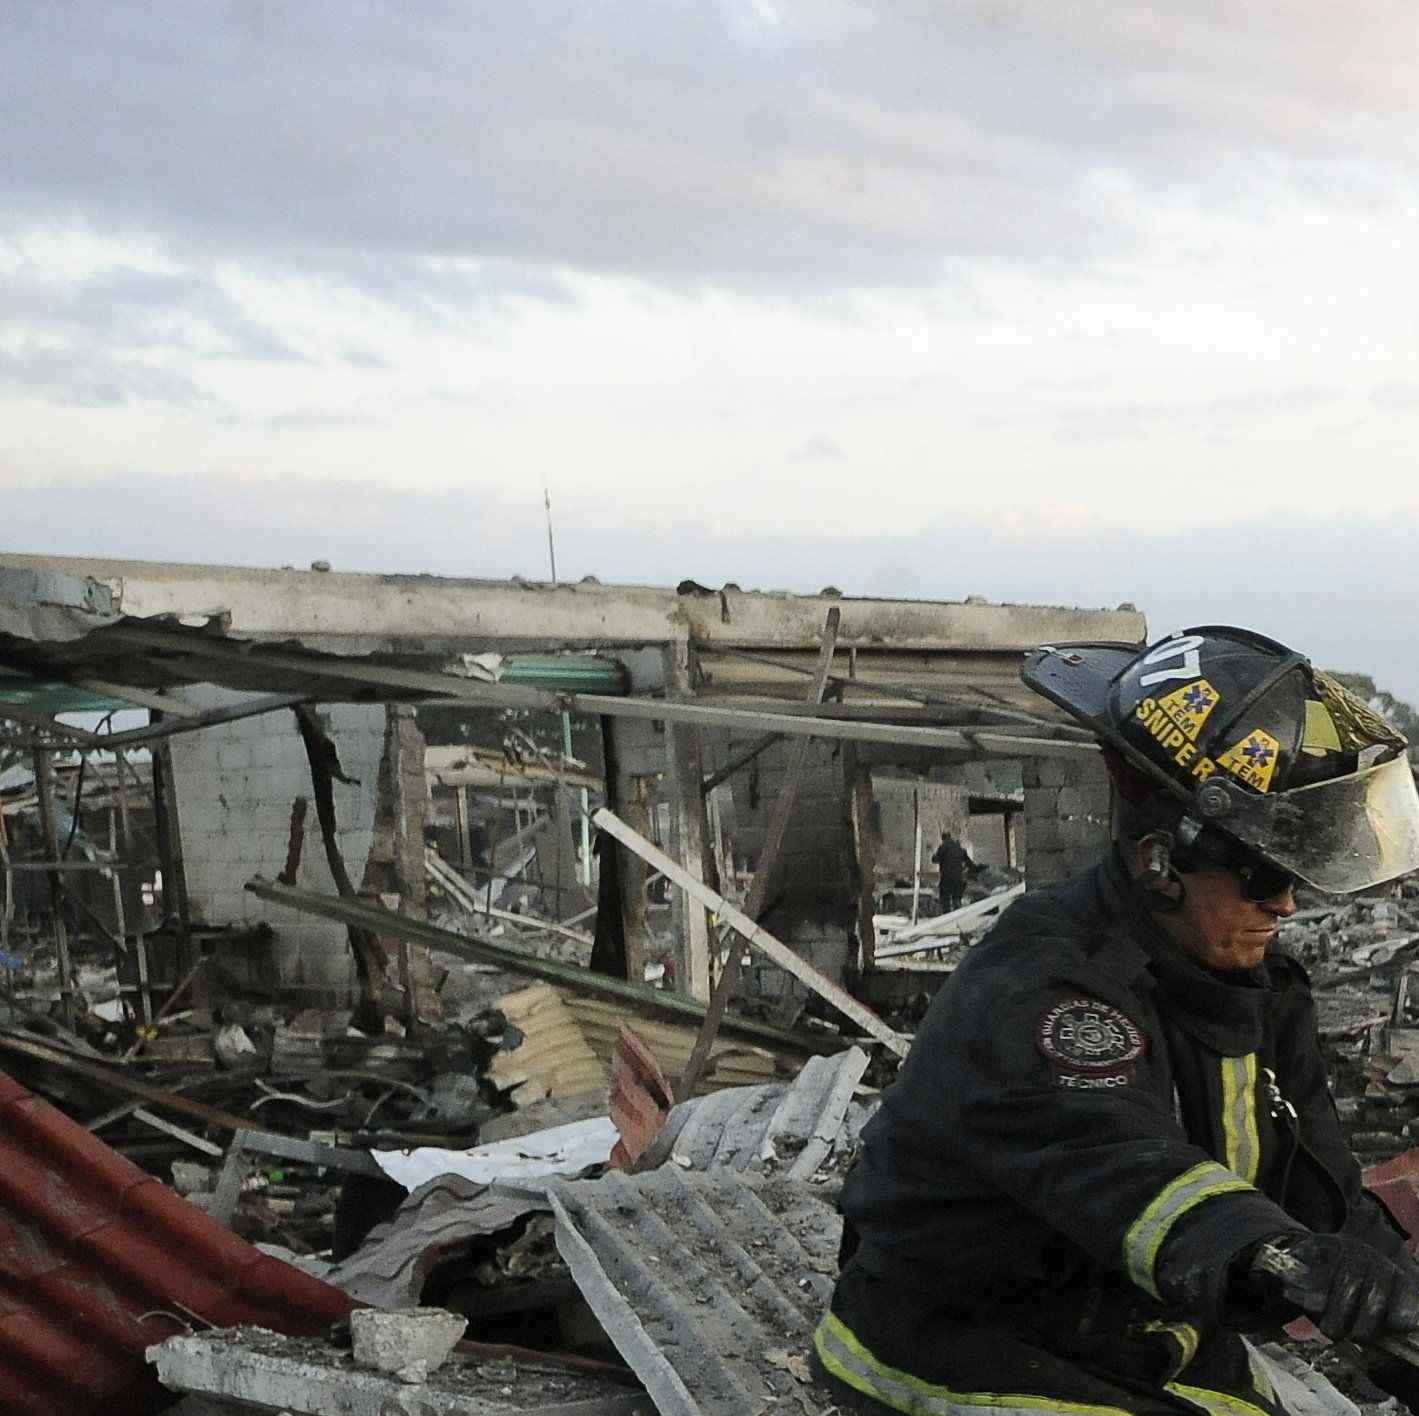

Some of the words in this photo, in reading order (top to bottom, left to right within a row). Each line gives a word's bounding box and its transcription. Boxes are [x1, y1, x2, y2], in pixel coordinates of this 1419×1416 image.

[1165, 698, 1196, 733] TEM
[1136, 697, 1217, 784] SNIPER
[1229, 757, 1264, 787] TEM
